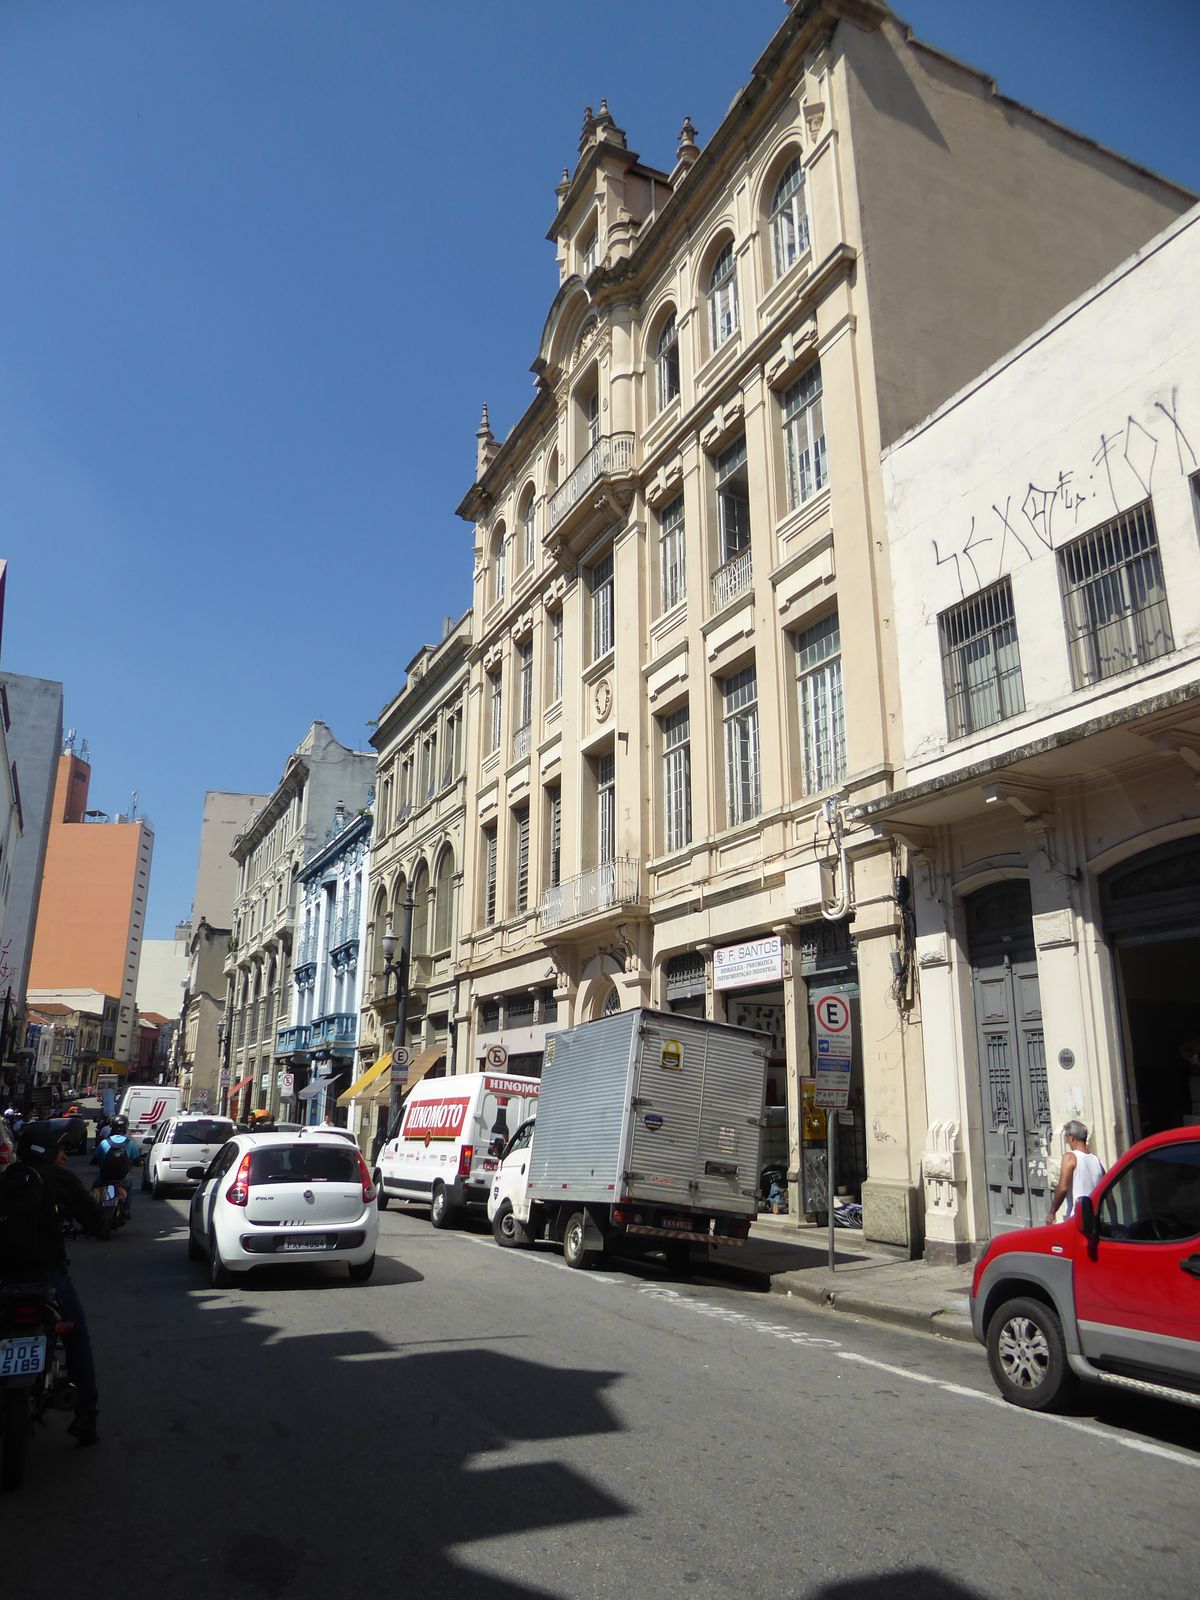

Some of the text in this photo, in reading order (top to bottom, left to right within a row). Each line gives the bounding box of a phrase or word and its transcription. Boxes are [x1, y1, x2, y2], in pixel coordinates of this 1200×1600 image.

[729, 940, 778, 961] F. SANTOS
[826, 1003, 839, 1024] E
[397, 1051, 404, 1061] E
[407, 1104, 463, 1128] HINOMOTO
[5, 1345, 39, 1360] DOE
[2, 1358, 40, 1373] 5189
